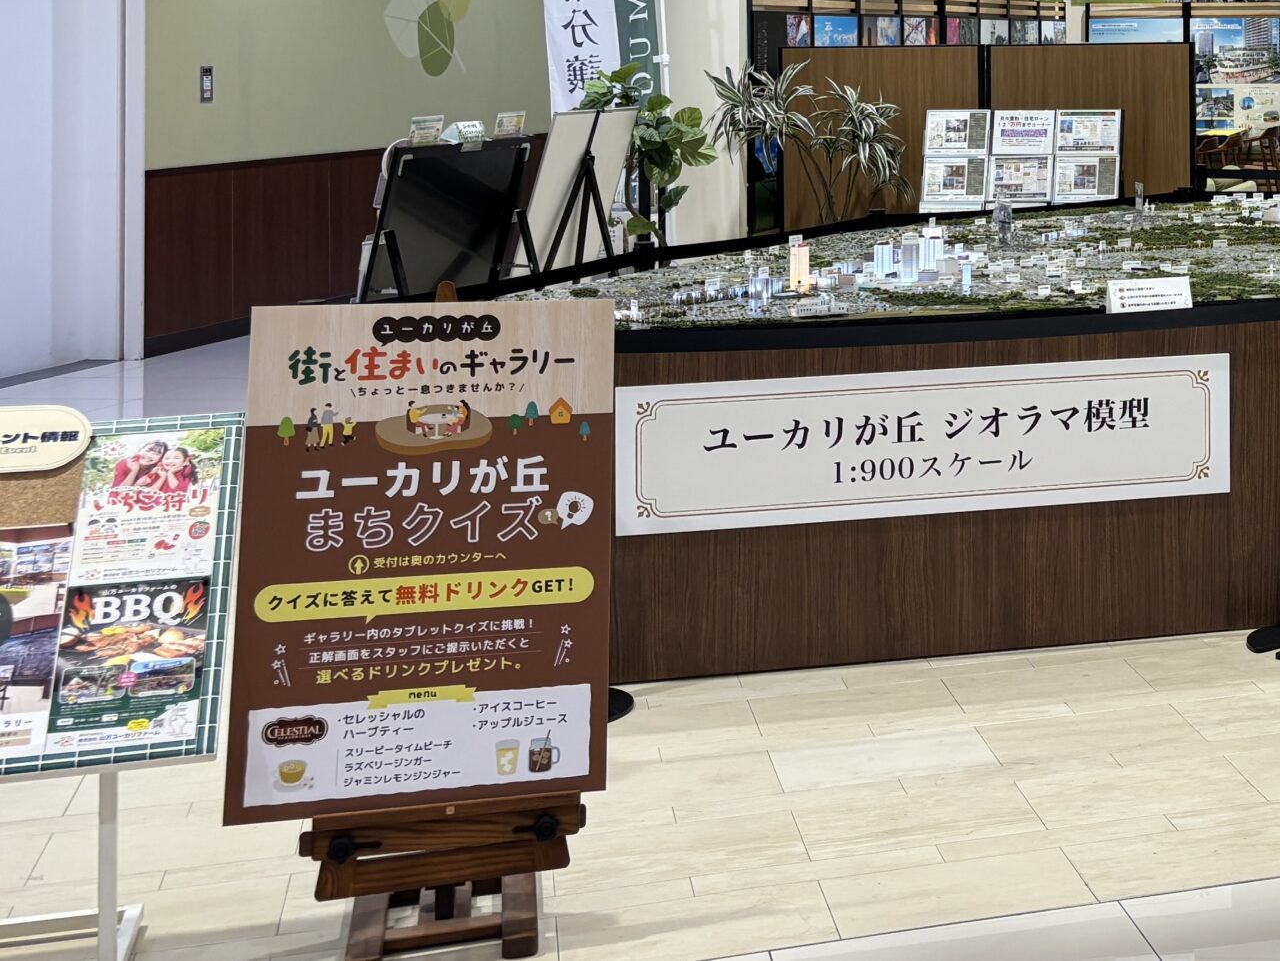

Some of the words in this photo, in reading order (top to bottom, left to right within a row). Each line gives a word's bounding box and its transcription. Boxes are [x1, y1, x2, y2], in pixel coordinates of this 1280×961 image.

[380, 321, 494, 337] ユーカリが丘
[288, 346, 576, 386] 街と住まいのギャラリー
[357, 381, 516, 397] ちょっと一息つきませんか？
[702, 409, 927, 454] ユーカリが丘
[944, 396, 1152, 441] ジオラマ模型
[295, 454, 549, 500] ユーカリが丘
[832, 449, 1034, 485] 1:900スケール
[305, 495, 543, 552] まちクイズ
[373, 552, 507, 570] 受付は奥のカウンターへ
[92, 591, 185, 626] BBQ
[303, 618, 534, 644] ギャラリー内のタブレットクイズに挑戦！
[308, 636, 529, 664] 正解画面をスタッフにご提示いただくと
[315, 655, 523, 685] 選べるドリンクプレゼント。
[266, 724, 322, 740] CELESTIAL
[343, 724, 414, 740] ハーブティー
